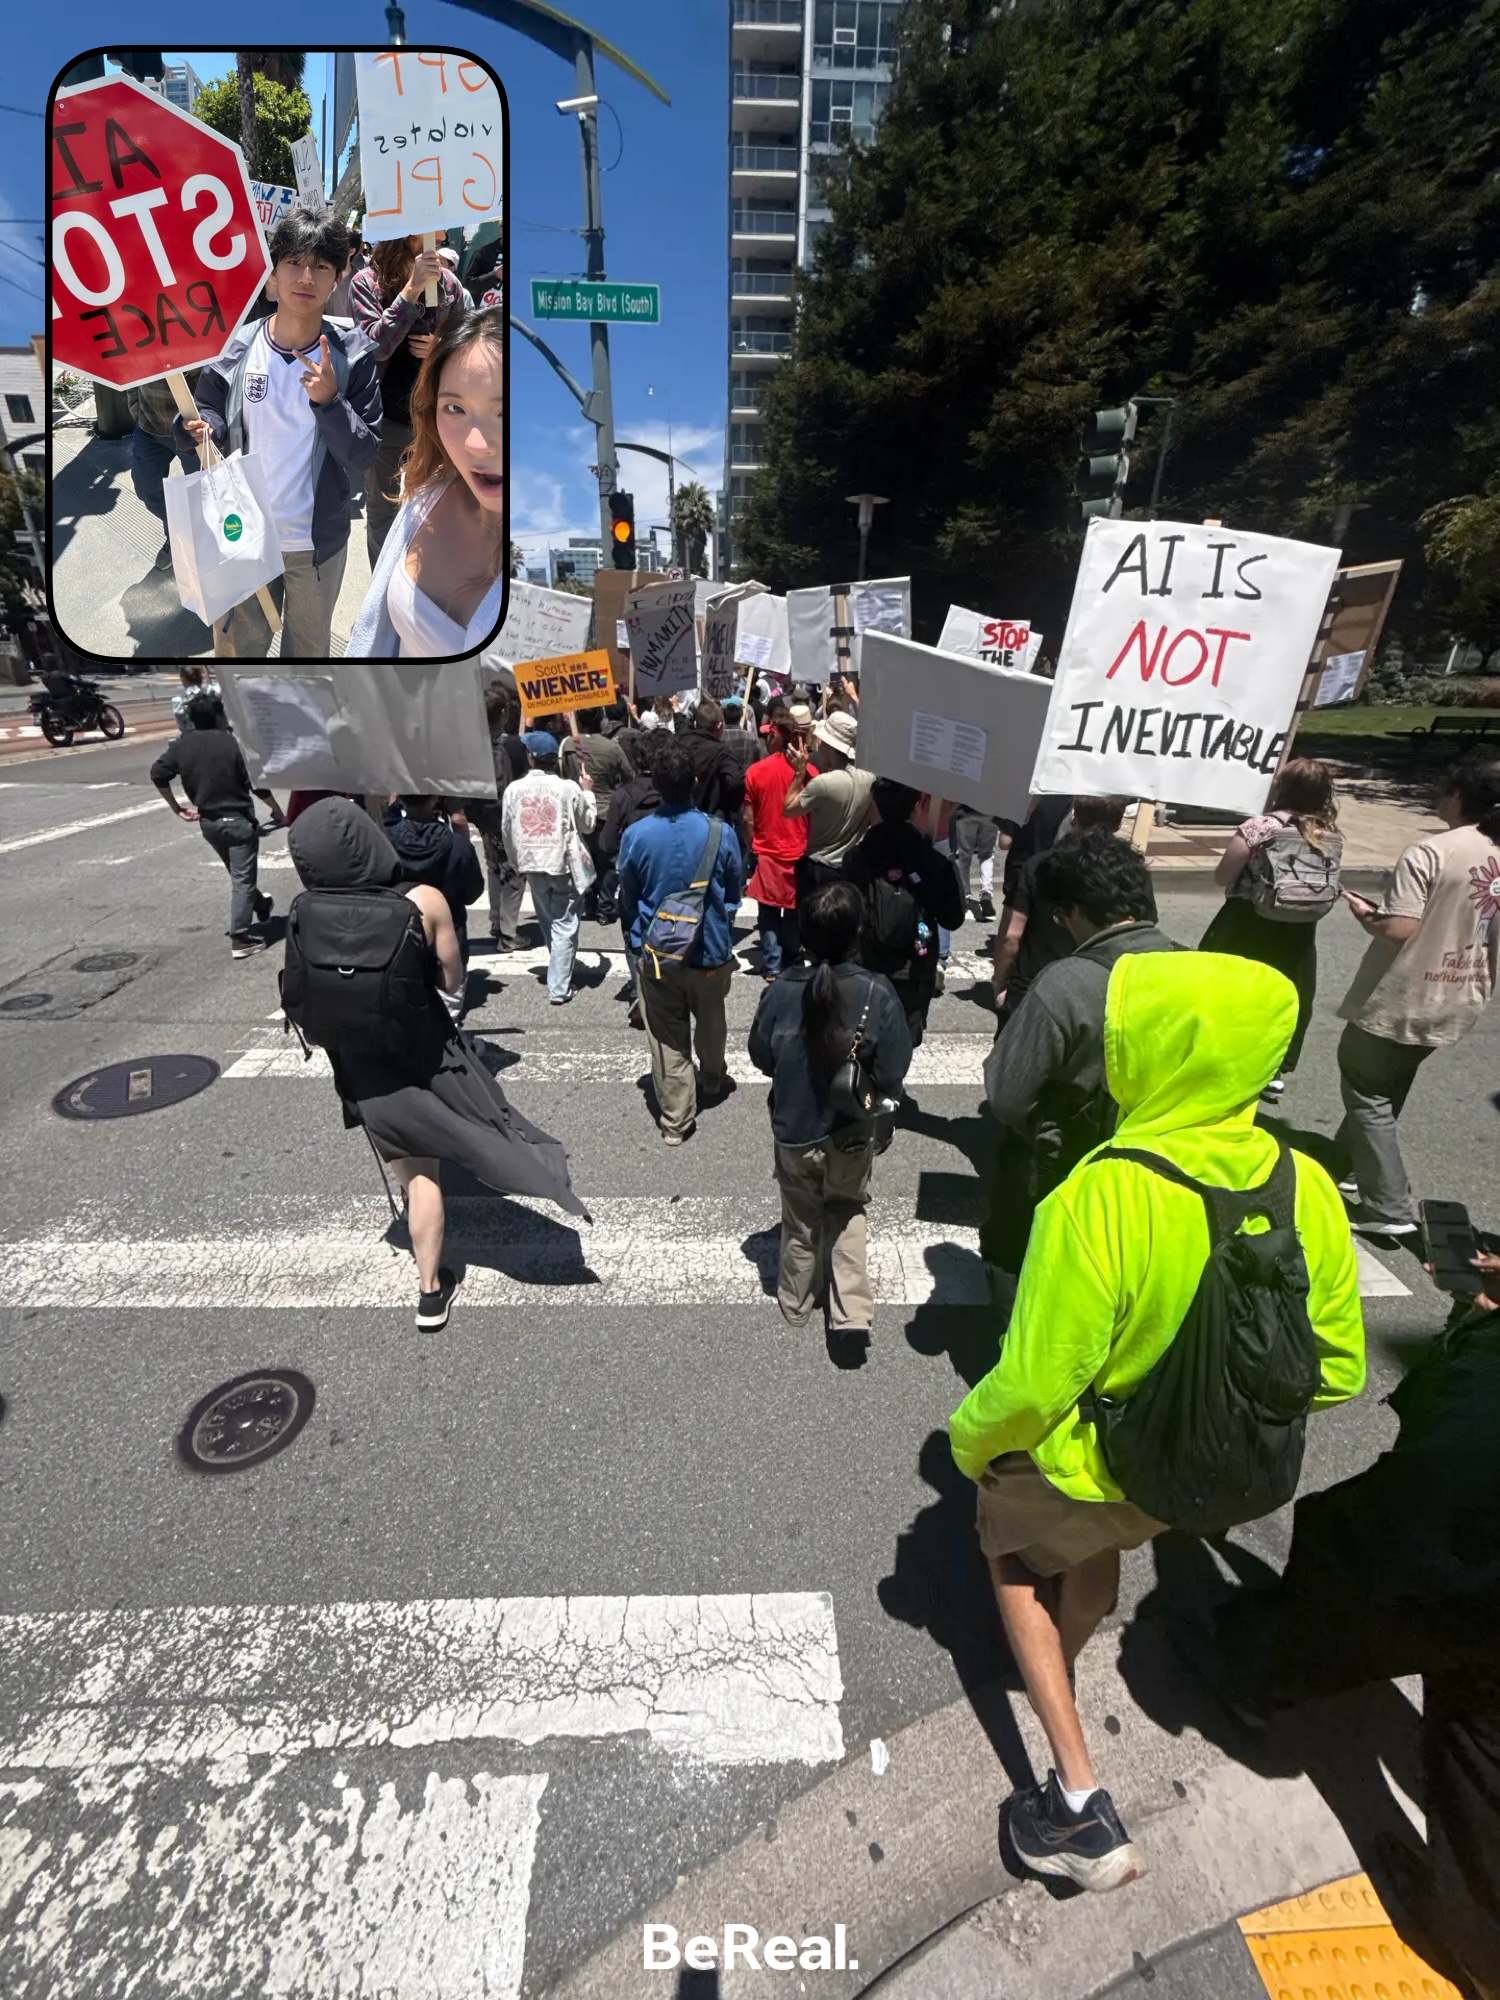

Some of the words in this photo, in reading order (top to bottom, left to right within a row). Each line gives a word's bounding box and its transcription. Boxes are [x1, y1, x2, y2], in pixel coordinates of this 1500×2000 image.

[537, 290, 571, 311] Mission
[576, 292, 594, 317] Bay
[597, 293, 617, 313] Blvd
[621, 292, 653, 317] (South)
[1101, 533, 1185, 597] AI
[1202, 543, 1268, 601] IS
[636, 603, 694, 678] HUMANITY
[982, 621, 1029, 651] STOP
[979, 650, 1015, 668] THE
[1105, 619, 1251, 688] NOT
[521, 668, 608, 700] WIENER
[534, 662, 568, 678] Scott
[527, 697, 563, 709] DEMOCRAT
[574, 690, 611, 702] CONGRESS
[1057, 701, 1289, 775] INEVITABLE
[1424, 970, 1468, 991] nothing
